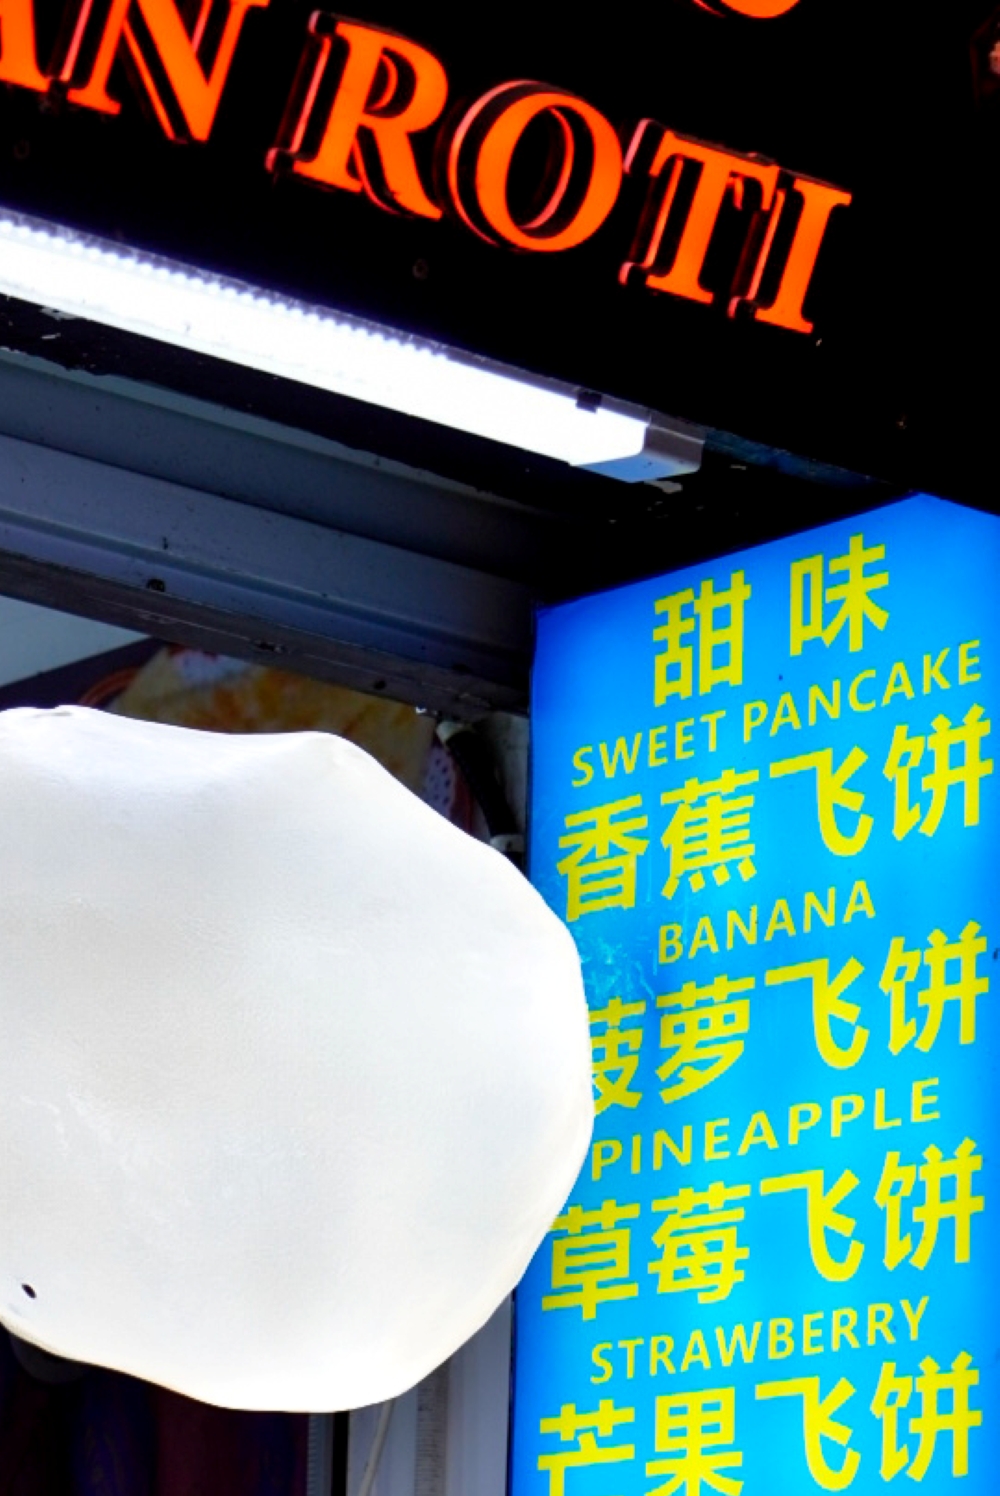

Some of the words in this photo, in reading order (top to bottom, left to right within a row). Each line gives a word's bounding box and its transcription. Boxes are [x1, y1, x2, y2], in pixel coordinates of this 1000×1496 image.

[280, 16, 852, 334] ROTI
[652, 533, 890, 707] 甜味
[572, 710, 727, 788] SWEET
[743, 639, 982, 743] PANCAKE
[557, 703, 994, 923] 香蕉飞饼
[658, 880, 876, 965] BANANA
[591, 1077, 941, 1181] PINEAPPLE
[542, 1137, 985, 1321] 草莓飞饼
[590, 1296, 930, 1384] STRAWBERRY
